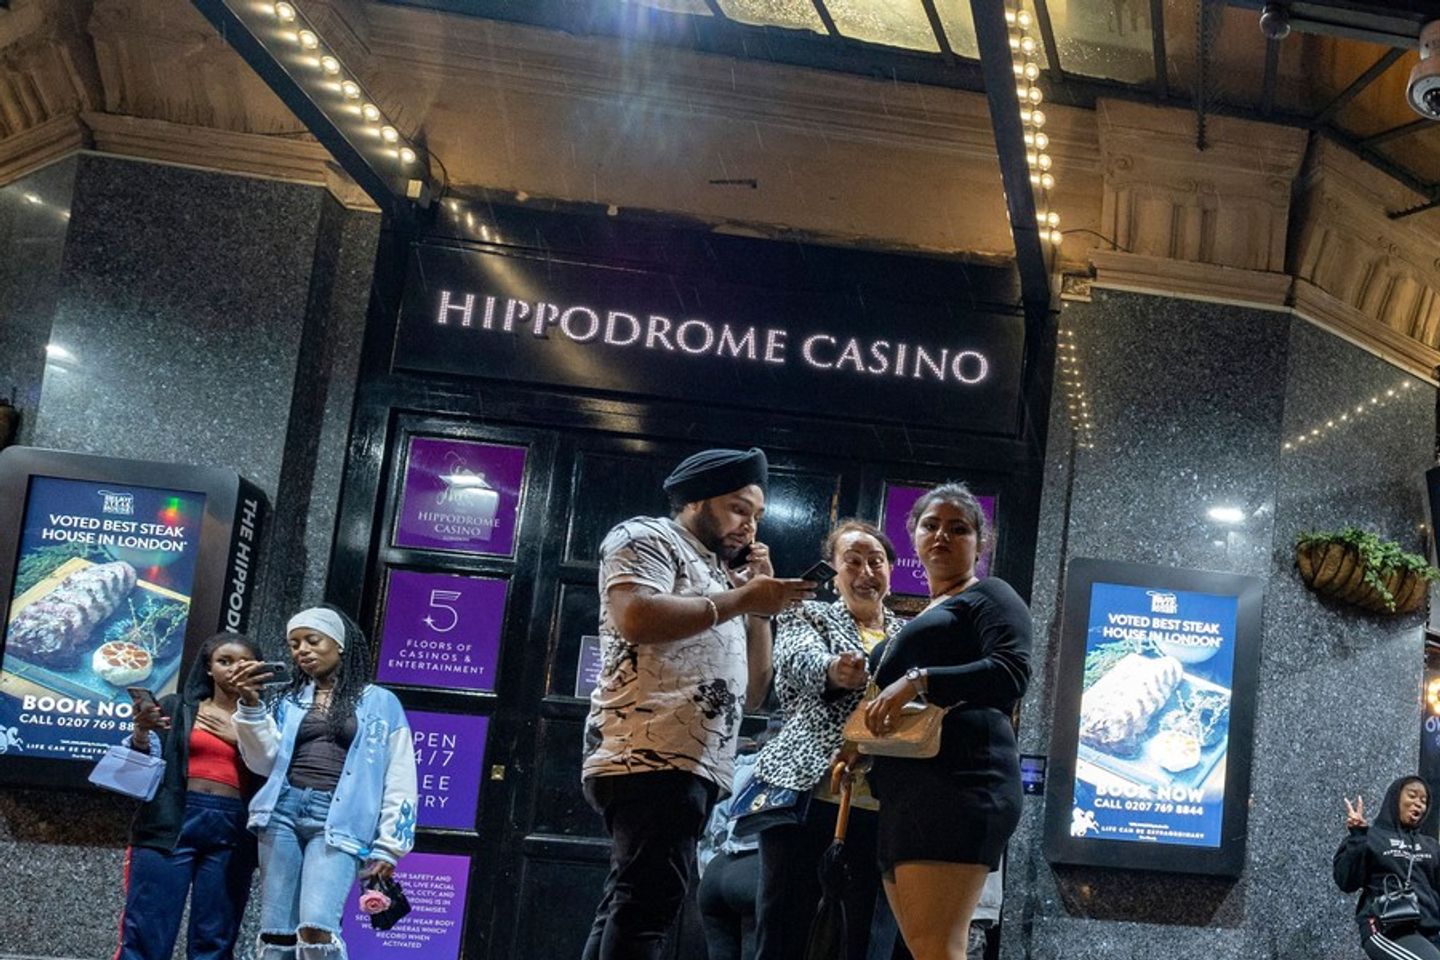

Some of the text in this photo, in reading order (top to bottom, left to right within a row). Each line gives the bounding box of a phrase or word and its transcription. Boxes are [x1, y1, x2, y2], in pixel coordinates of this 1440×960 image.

[437, 291, 989, 384] HIPPODROME CASINO
[49, 514, 185, 538] VOTED BEST STEAK
[239, 499, 258, 541] THE
[417, 511, 501, 529] HIPPODROME
[41, 528, 94, 545] HOUSE
[97, 533, 115, 546] IN
[434, 523, 482, 537] CASINO
[1107, 612, 1221, 635] VOTED BEST STEAK
[1103, 626, 1148, 641] HOUSE
[1149, 631, 1164, 642] IN
[406, 639, 473, 653] FLOORS OF
[399, 649, 472, 662] CASINOS &
[388, 659, 486, 676] ENTERTAINMENT
[22, 694, 134, 718] BOOK NO
[19, 713, 136, 731] CALL 0207 769 88
[413, 731, 457, 749] PEN
[413, 748, 455, 767] 4/7
[422, 774, 452, 791] EE
[1095, 782, 1205, 803] BOOK NOW
[1094, 798, 1123, 810] CALL
[1125, 800, 1152, 812] 0207
[1154, 802, 1174, 814] 769
